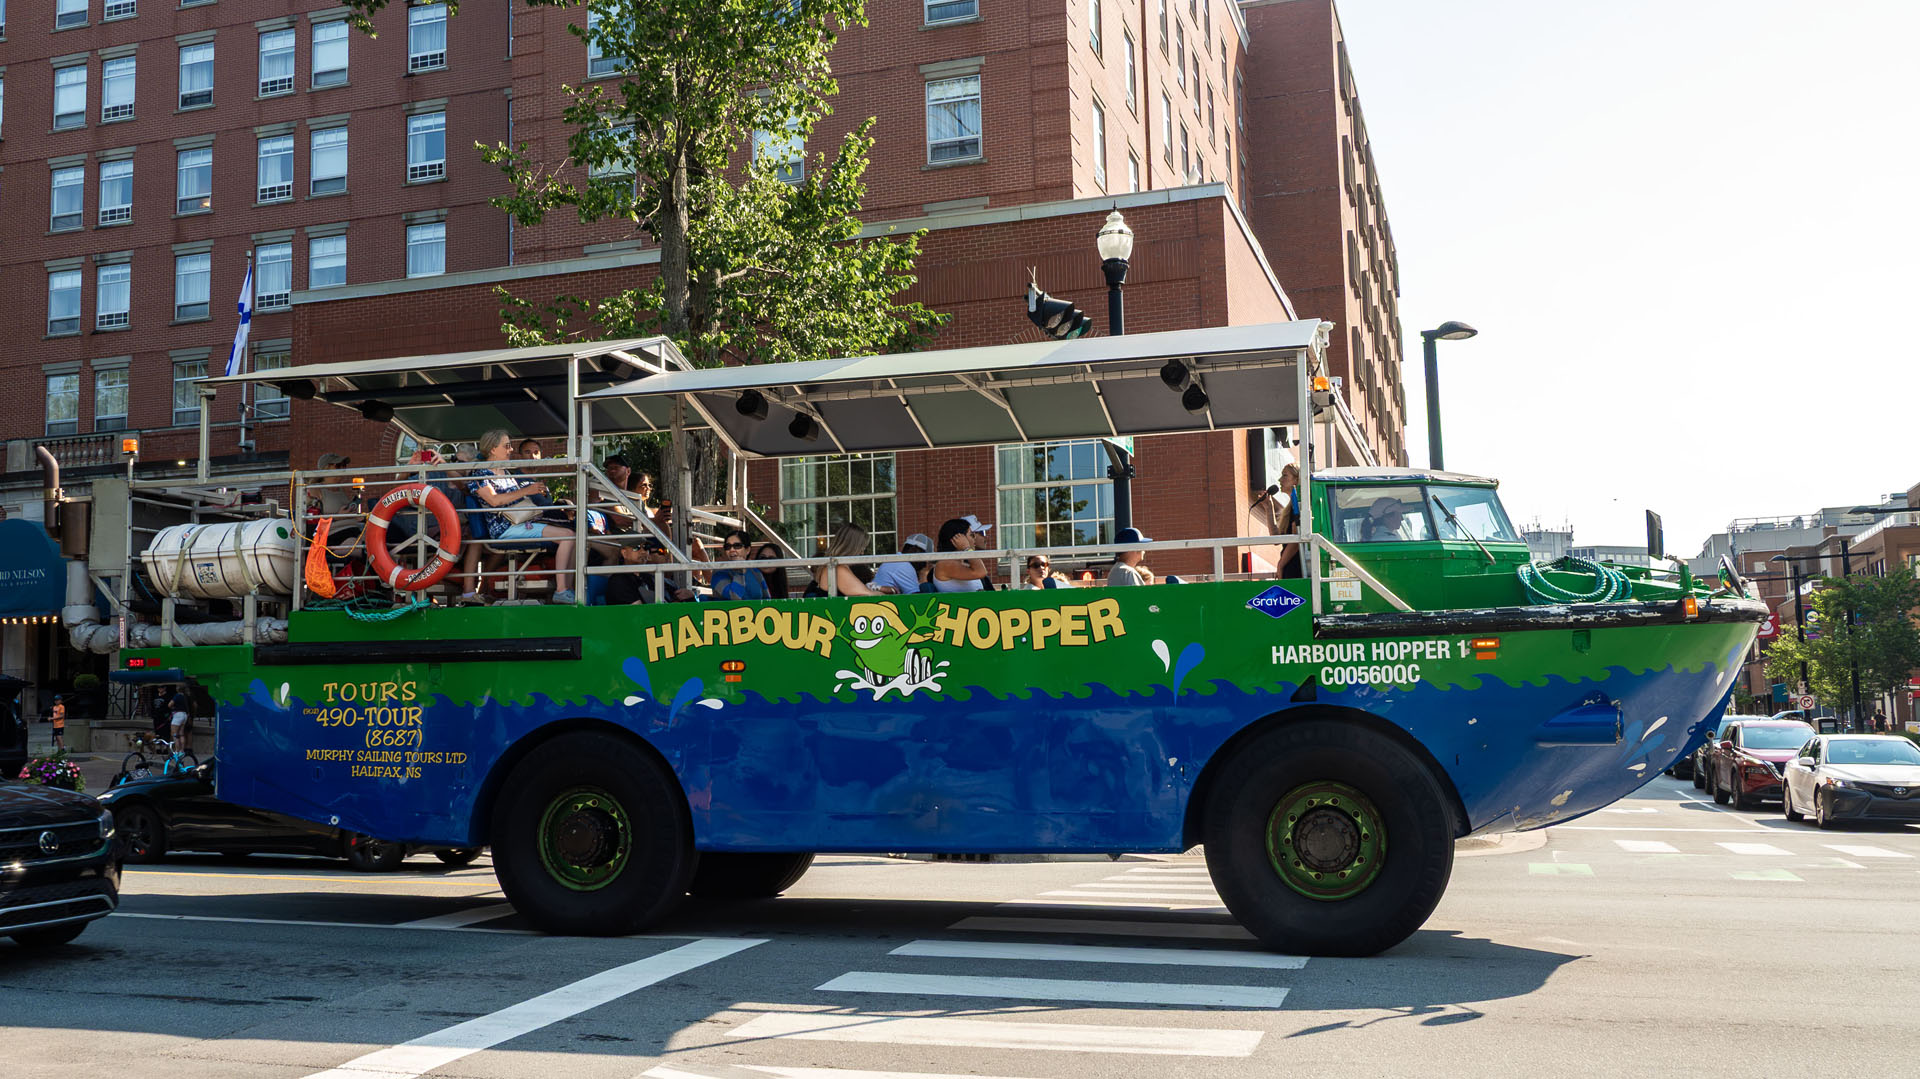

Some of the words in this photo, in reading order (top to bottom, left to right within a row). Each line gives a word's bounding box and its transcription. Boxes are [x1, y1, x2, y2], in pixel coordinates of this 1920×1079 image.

[13, 569, 46, 579] NELSON
[645, 606, 836, 663] HARBOUR
[932, 597, 1127, 651] HOPPER
[1271, 644, 1365, 665] HARBOUR
[1371, 640, 1451, 661] HOPPER
[323, 681, 417, 702] TOURS
[316, 706, 423, 727] 490-TOUR
[365, 728, 423, 748] (8687)
[306, 749, 354, 762] MURPHY
[356, 750, 402, 763] SAILING
[405, 751, 443, 764] TOURS
[445, 752, 468, 764] LTD
[405, 767, 422, 779] NS
